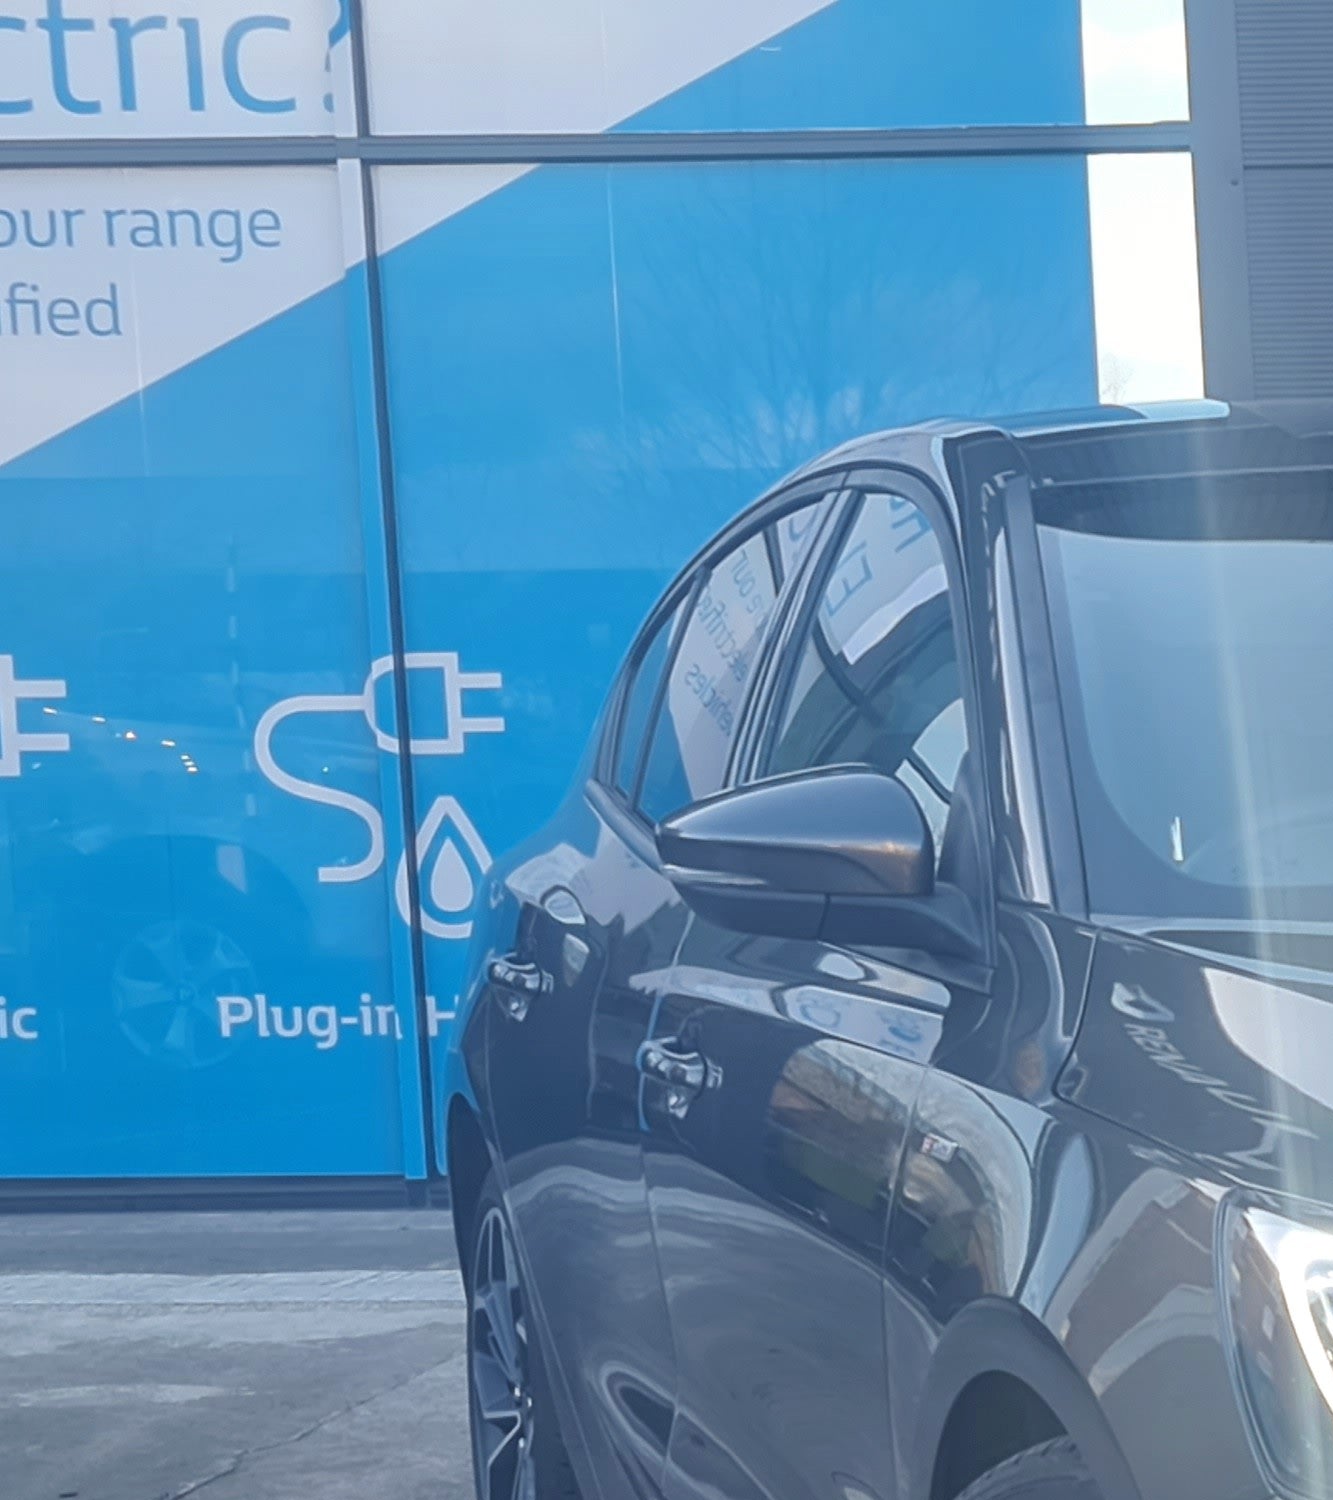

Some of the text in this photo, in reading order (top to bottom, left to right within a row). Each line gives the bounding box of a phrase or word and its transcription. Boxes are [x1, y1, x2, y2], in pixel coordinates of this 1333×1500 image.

[103, 208, 282, 262] range
[0, 282, 122, 336] fied
[217, 993, 402, 1050] Plug-in
